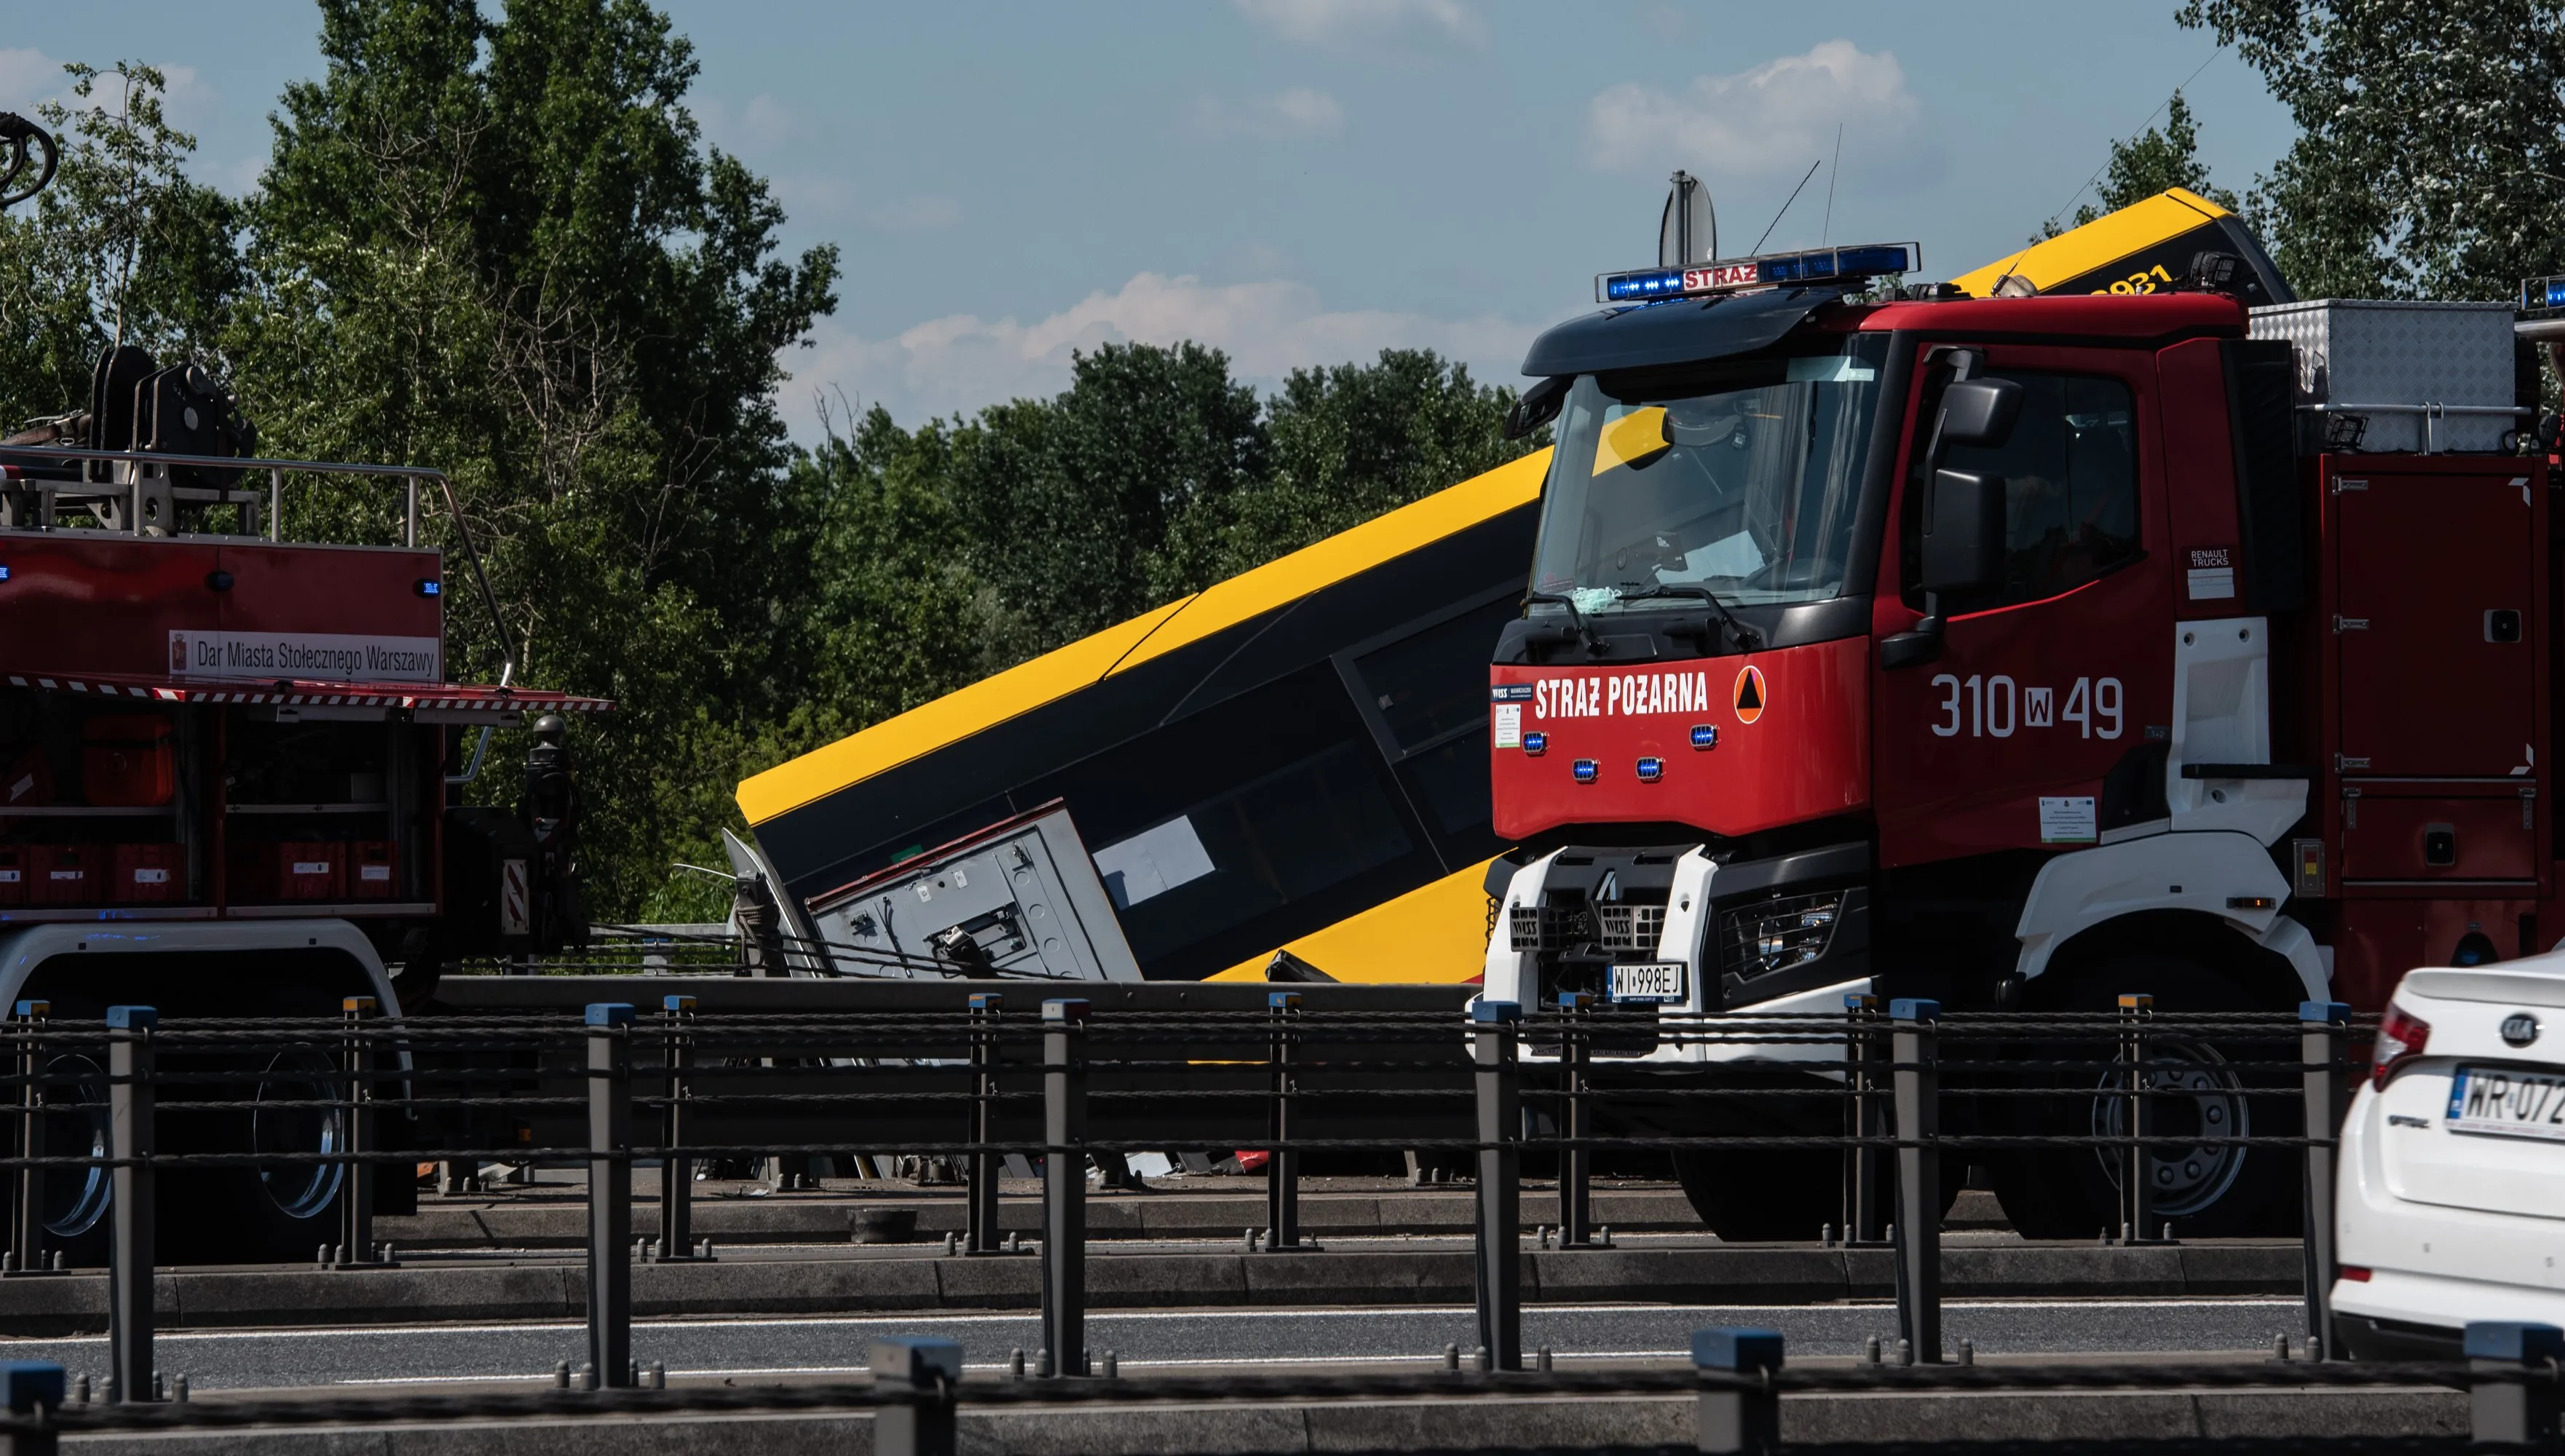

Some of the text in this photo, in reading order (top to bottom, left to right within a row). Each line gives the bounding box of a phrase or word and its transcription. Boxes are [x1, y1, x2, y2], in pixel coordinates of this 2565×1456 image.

[2090, 264, 2173, 295] 931
[2191, 549, 2228, 559] RENAULT
[2192, 558, 2229, 567] TRUCKS
[197, 641, 433, 677] Dar Miasta Stołecznego Warszawy
[1492, 688, 1508, 699] WISS
[1931, 674, 2123, 739] 310 W 49
[1513, 921, 1537, 935] WISS
[1604, 919, 1630, 934] WISS
[2467, 1073, 2509, 1119] WR
